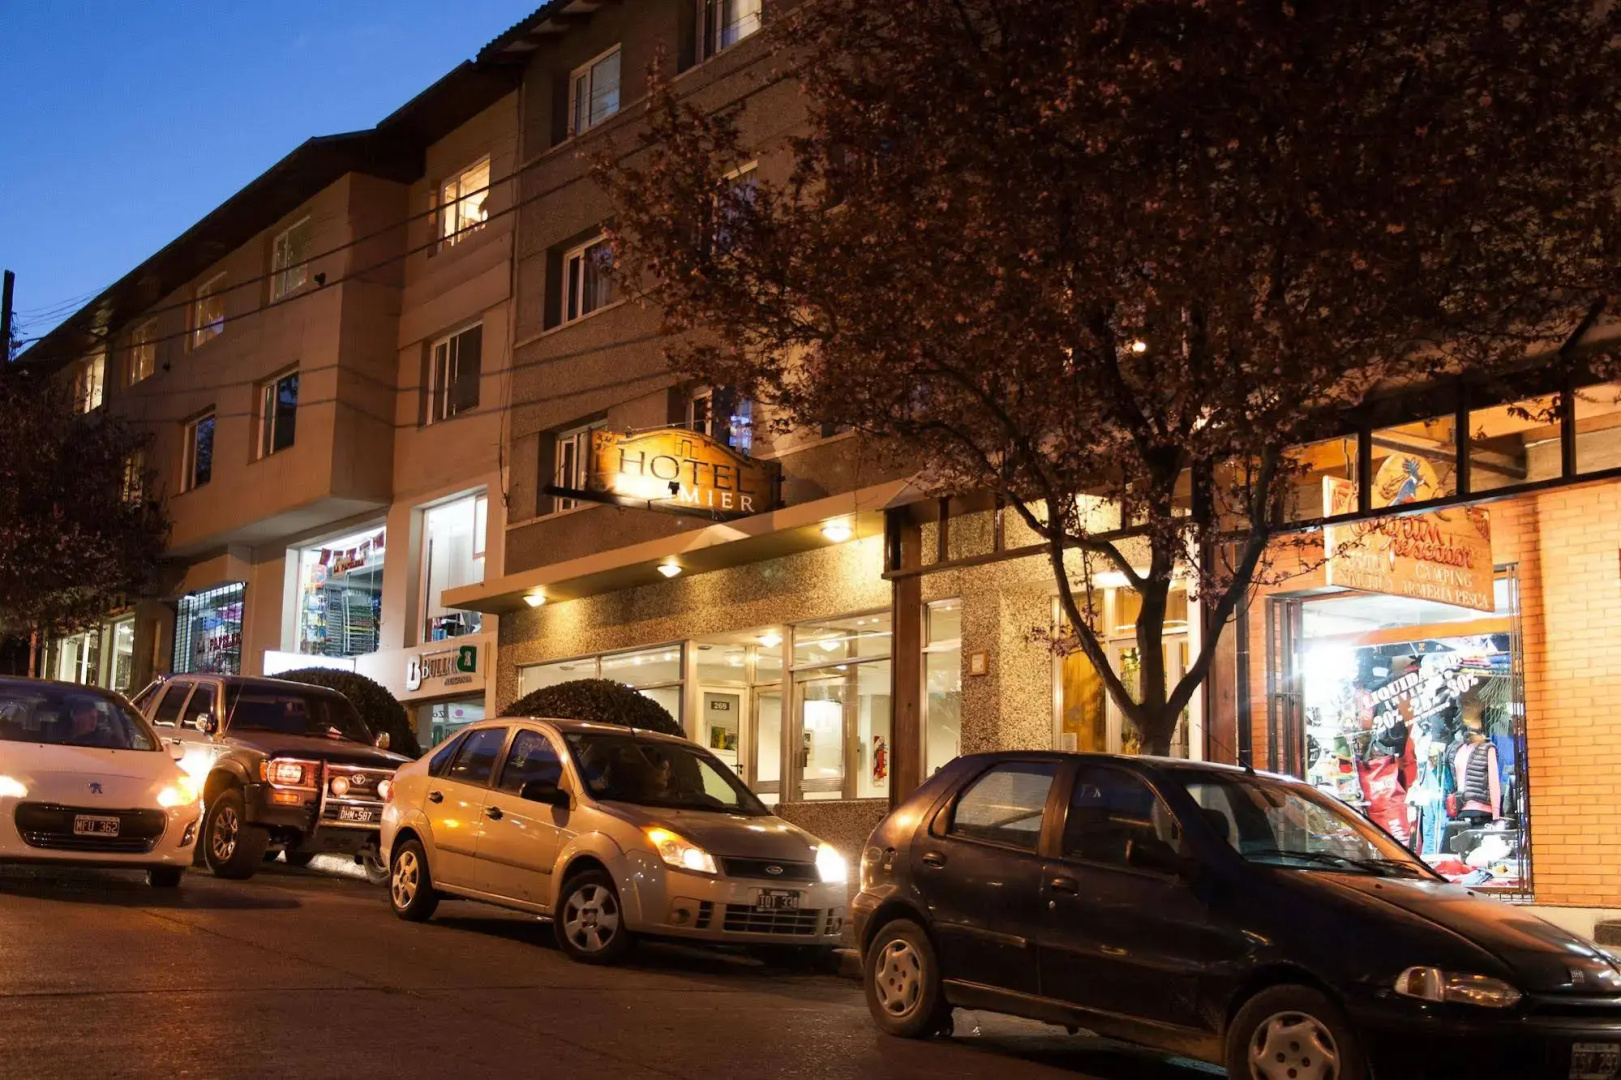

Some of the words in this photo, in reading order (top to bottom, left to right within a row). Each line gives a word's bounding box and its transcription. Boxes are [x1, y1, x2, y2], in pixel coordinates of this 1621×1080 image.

[618, 447, 755, 495] HOTEL
[1415, 563, 1473, 588] CAMPING
[1455, 589, 1490, 609] PESCA
[713, 702, 727, 710] 269
[76, 819, 95, 832] MFU
[100, 821, 118, 833] 362
